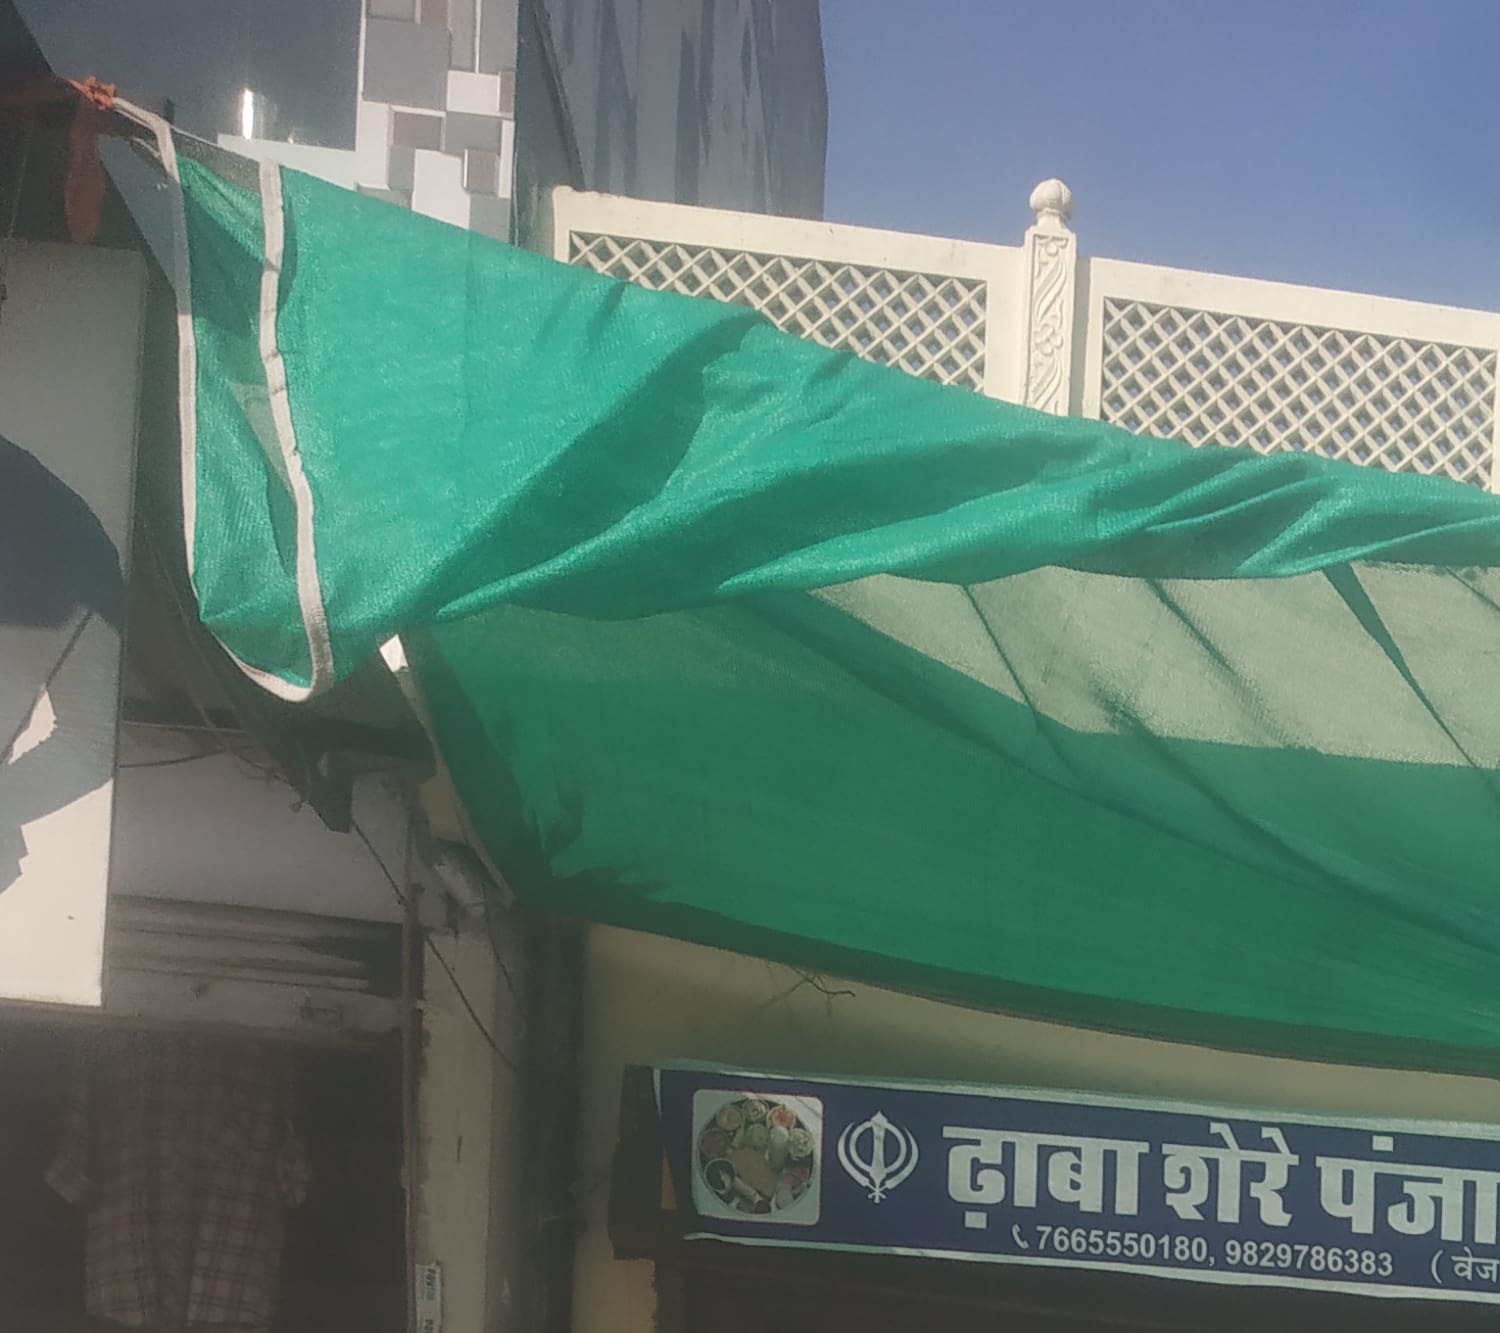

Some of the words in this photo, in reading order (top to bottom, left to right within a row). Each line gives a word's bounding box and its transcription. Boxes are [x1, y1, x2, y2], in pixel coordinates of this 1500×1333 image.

[1162, 1119, 1299, 1228] शेरे
[1036, 1225, 1216, 1266] 7665550180,
[1225, 1239, 1394, 1277] 9829786383
